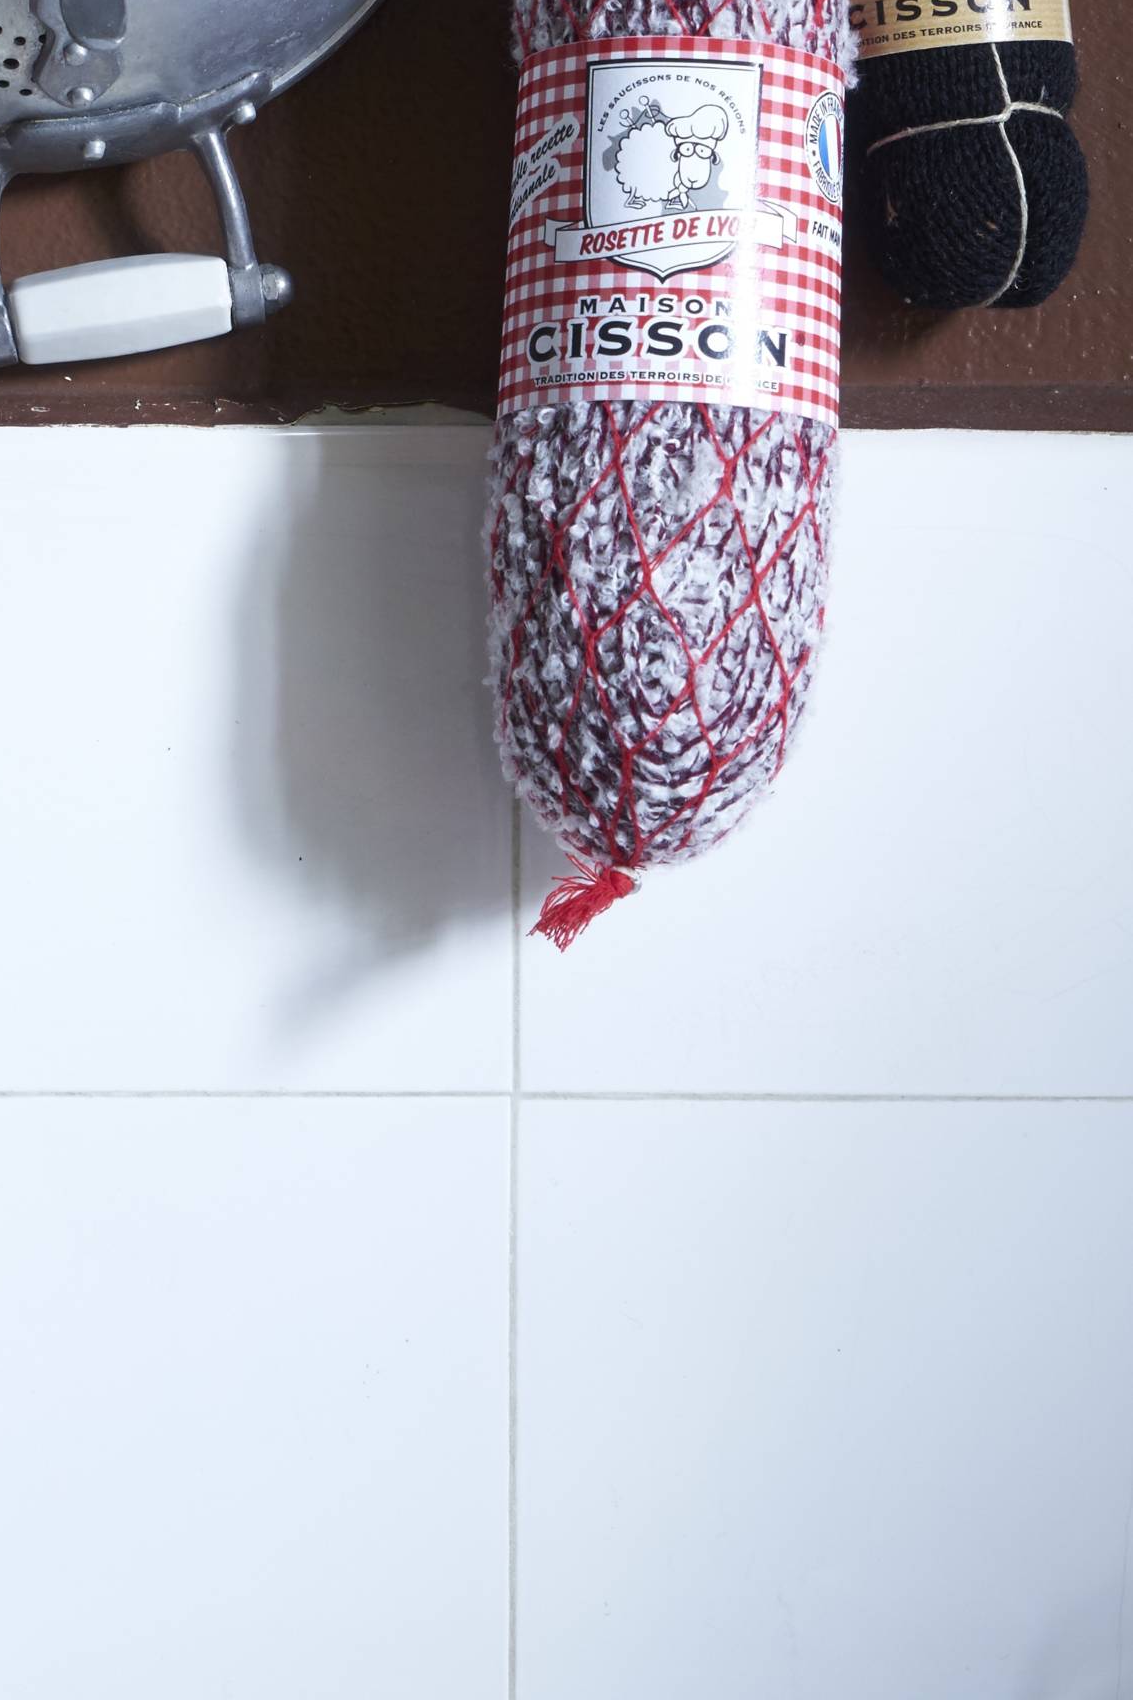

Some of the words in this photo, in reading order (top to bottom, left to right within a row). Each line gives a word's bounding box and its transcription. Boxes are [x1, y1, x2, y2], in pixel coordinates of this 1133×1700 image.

[893, 31, 916, 41] DES
[920, 23, 982, 37] TERROIRS
[1010, 20, 1043, 31] RANCE
[597, 112, 609, 133] LES
[608, 74, 672, 110] SAUCISSONS
[676, 74, 691, 82] DE
[694, 77, 716, 91] NOS
[718, 90, 746, 134] RÉGIONS
[530, 124, 575, 164] recette
[809, 108, 823, 145] MADE
[579, 221, 665, 256] ROSETTE
[671, 217, 700, 241] DE
[706, 214, 740, 238] LYO
[812, 221, 829, 240] FAIT
[579, 297, 729, 316] MAISON
[528, 320, 788, 368] CISSON
[534, 372, 596, 386] TRADITION
[598, 371, 624, 380] DES
[630, 372, 700, 382] TERROIRS
[705, 375, 722, 384] DE
